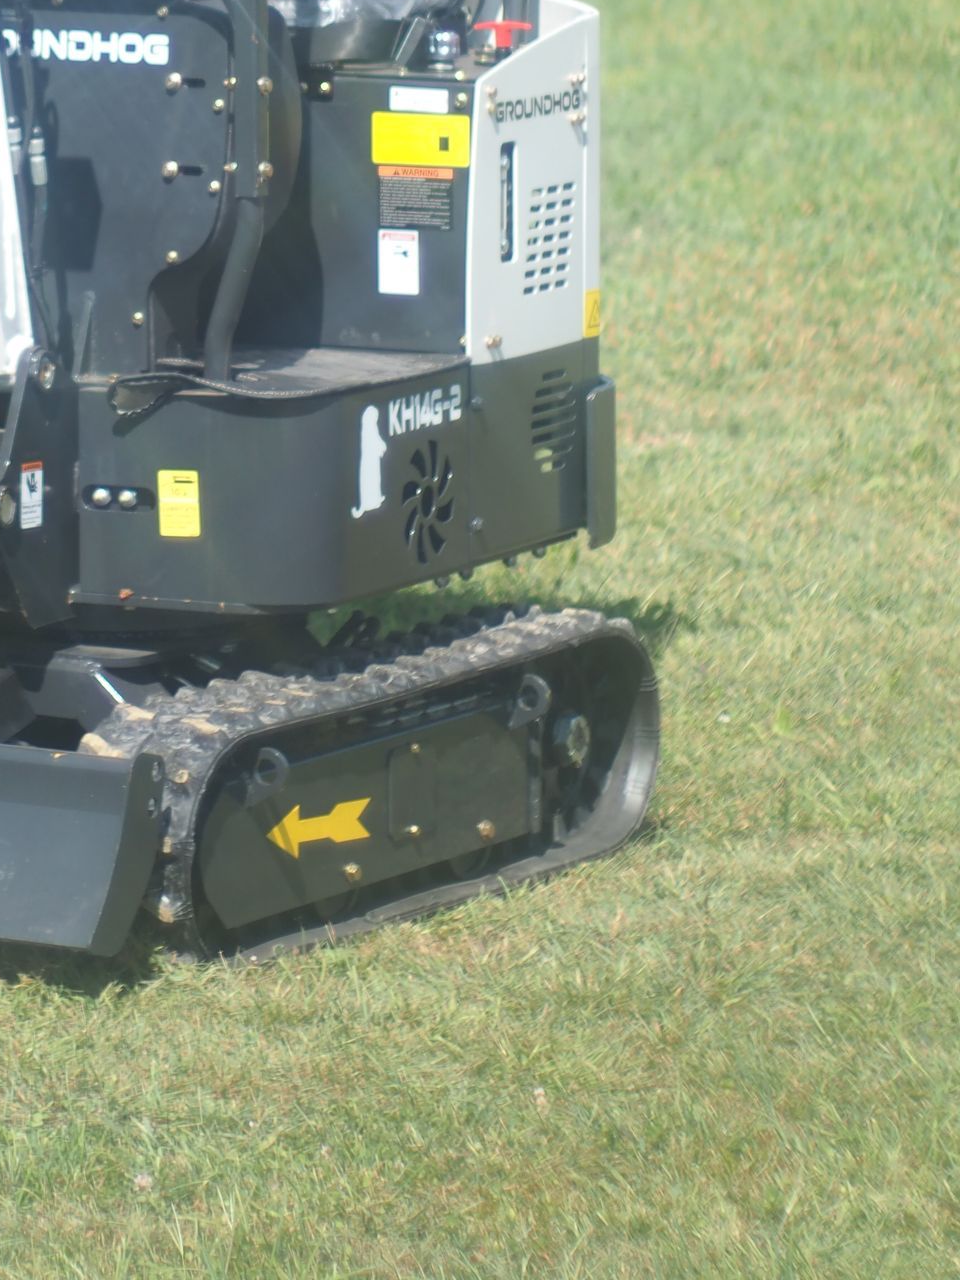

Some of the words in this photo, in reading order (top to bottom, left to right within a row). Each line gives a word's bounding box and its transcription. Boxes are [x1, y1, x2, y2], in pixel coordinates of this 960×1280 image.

[495, 89, 580, 122] GROUNDHOG
[401, 168, 439, 178] WARNING
[389, 384, 462, 437] KH14G-2
